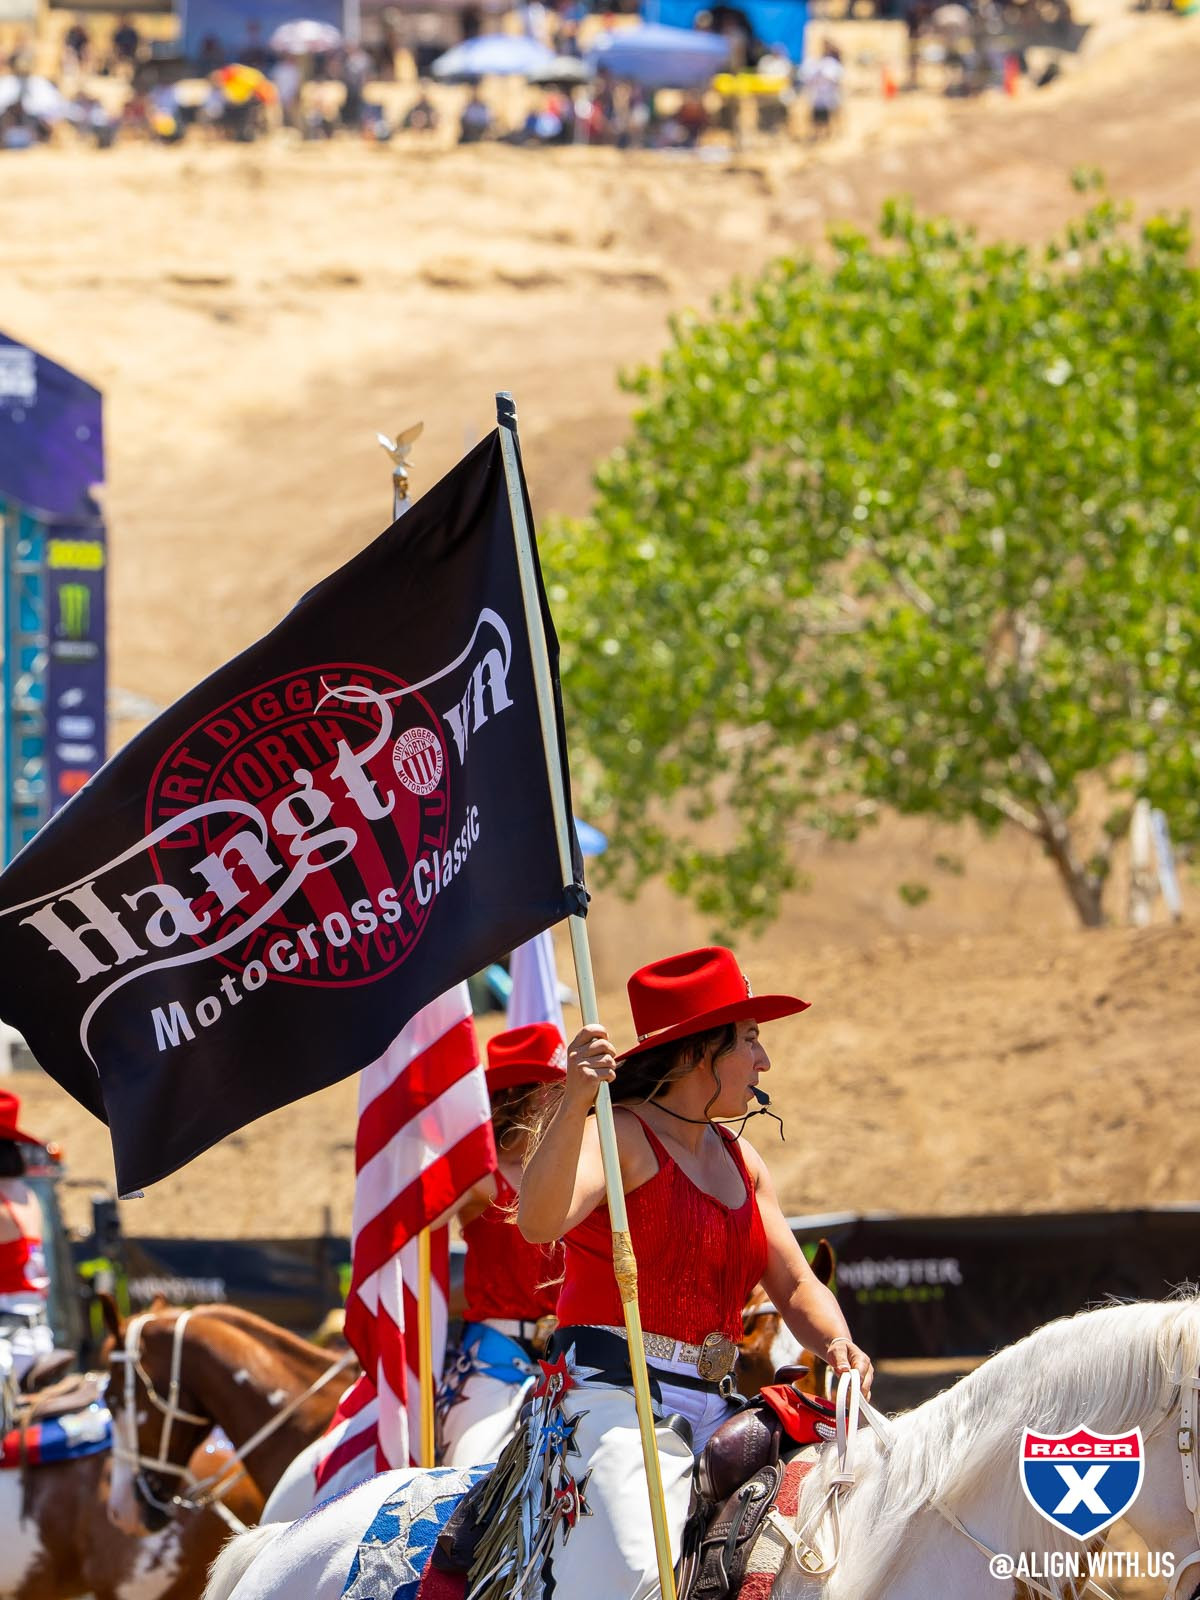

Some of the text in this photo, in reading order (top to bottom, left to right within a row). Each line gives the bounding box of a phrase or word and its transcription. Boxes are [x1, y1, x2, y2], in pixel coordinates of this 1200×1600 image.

[159, 673, 403, 848] DIRT DIGGERS
[393, 728, 436, 761] DIRT DIGGERS
[404, 739, 427, 758] NORTH
[214, 719, 348, 820] NORTH
[397, 769, 439, 794] MOTORCYCLE
[150, 805, 480, 1052] Motocross Classic
[837, 1257, 962, 1288] MONSTER
